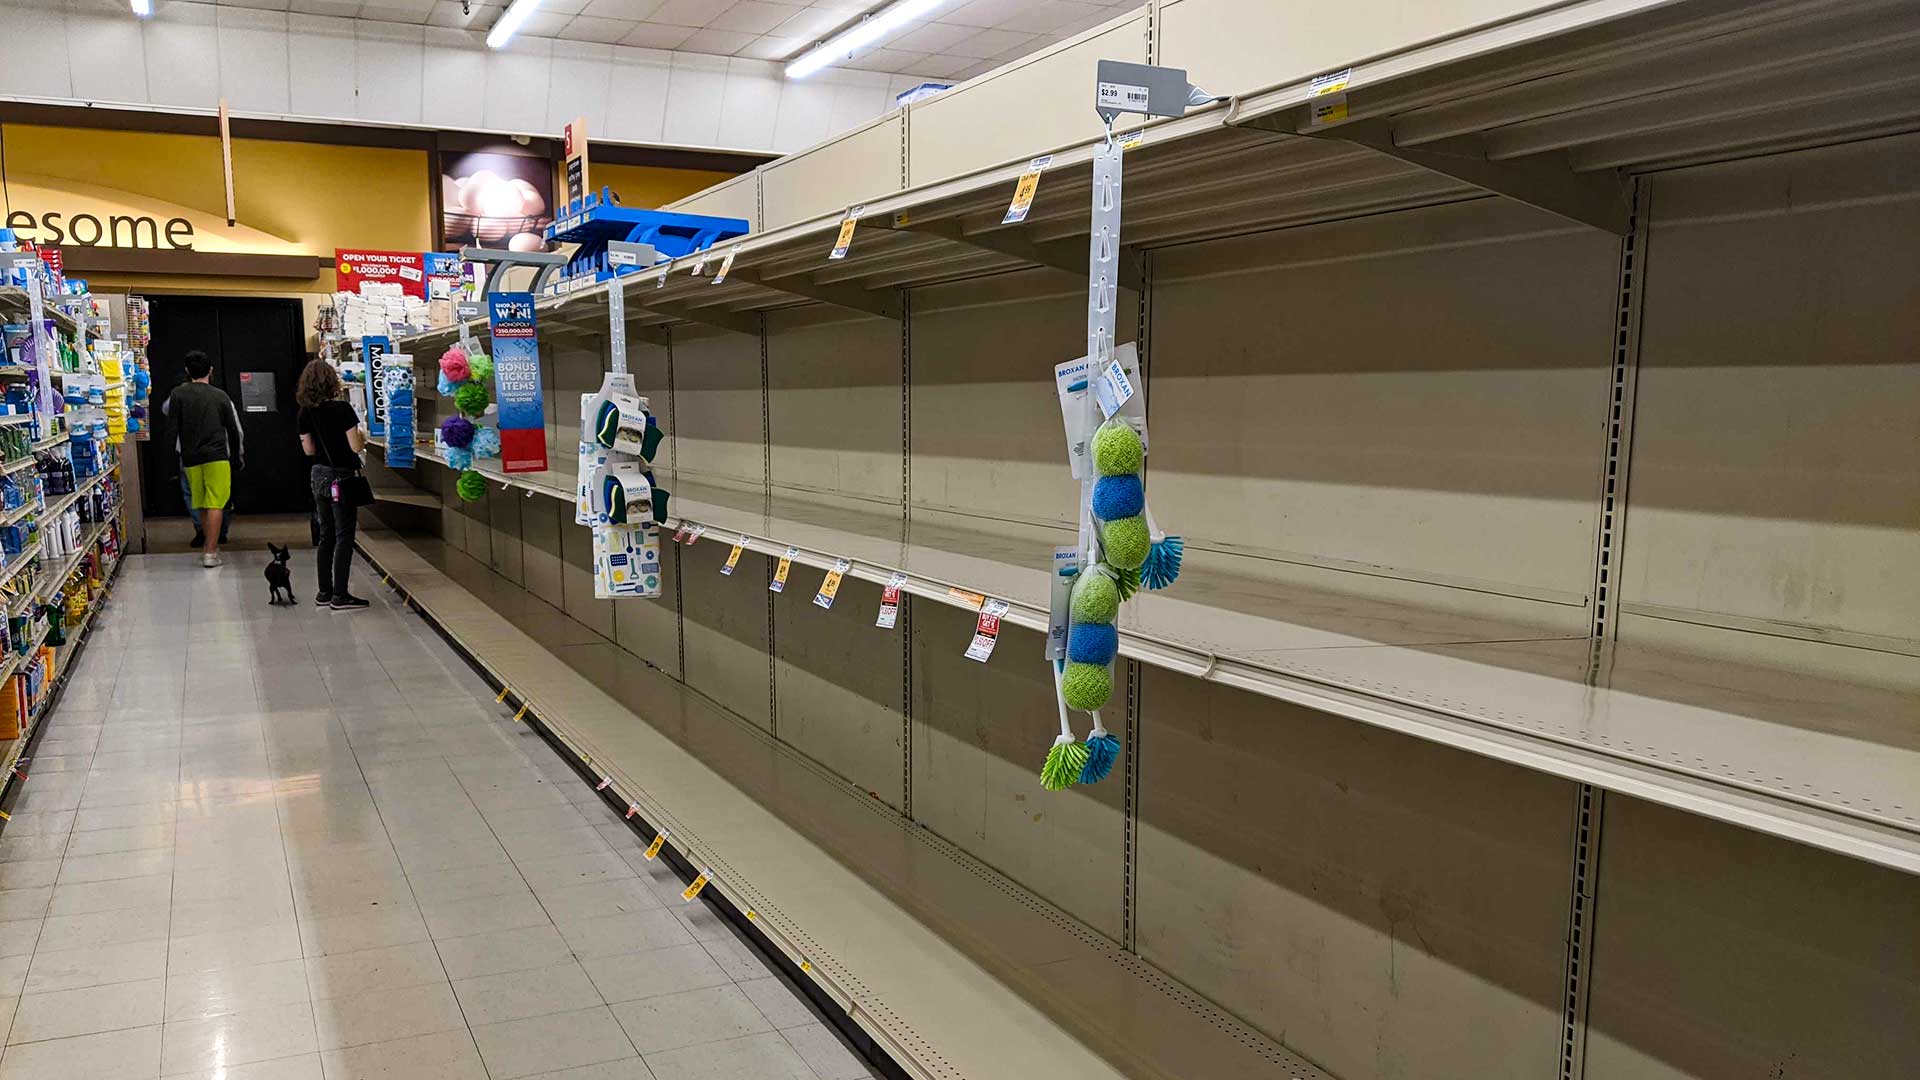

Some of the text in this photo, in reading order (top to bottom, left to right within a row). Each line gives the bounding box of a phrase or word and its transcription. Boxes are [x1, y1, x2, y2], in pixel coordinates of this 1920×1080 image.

[6, 210, 195, 250] esome
[343, 254, 416, 264] OPEN YOUR TICKET
[498, 363, 537, 372] BONUS
[1058, 364, 1084, 377] BROXAN
[498, 372, 537, 381] TICKET
[1111, 363, 1132, 398] BROXAN
[371, 346, 385, 421] MONOPOLY
[502, 381, 535, 391] ITEMS
